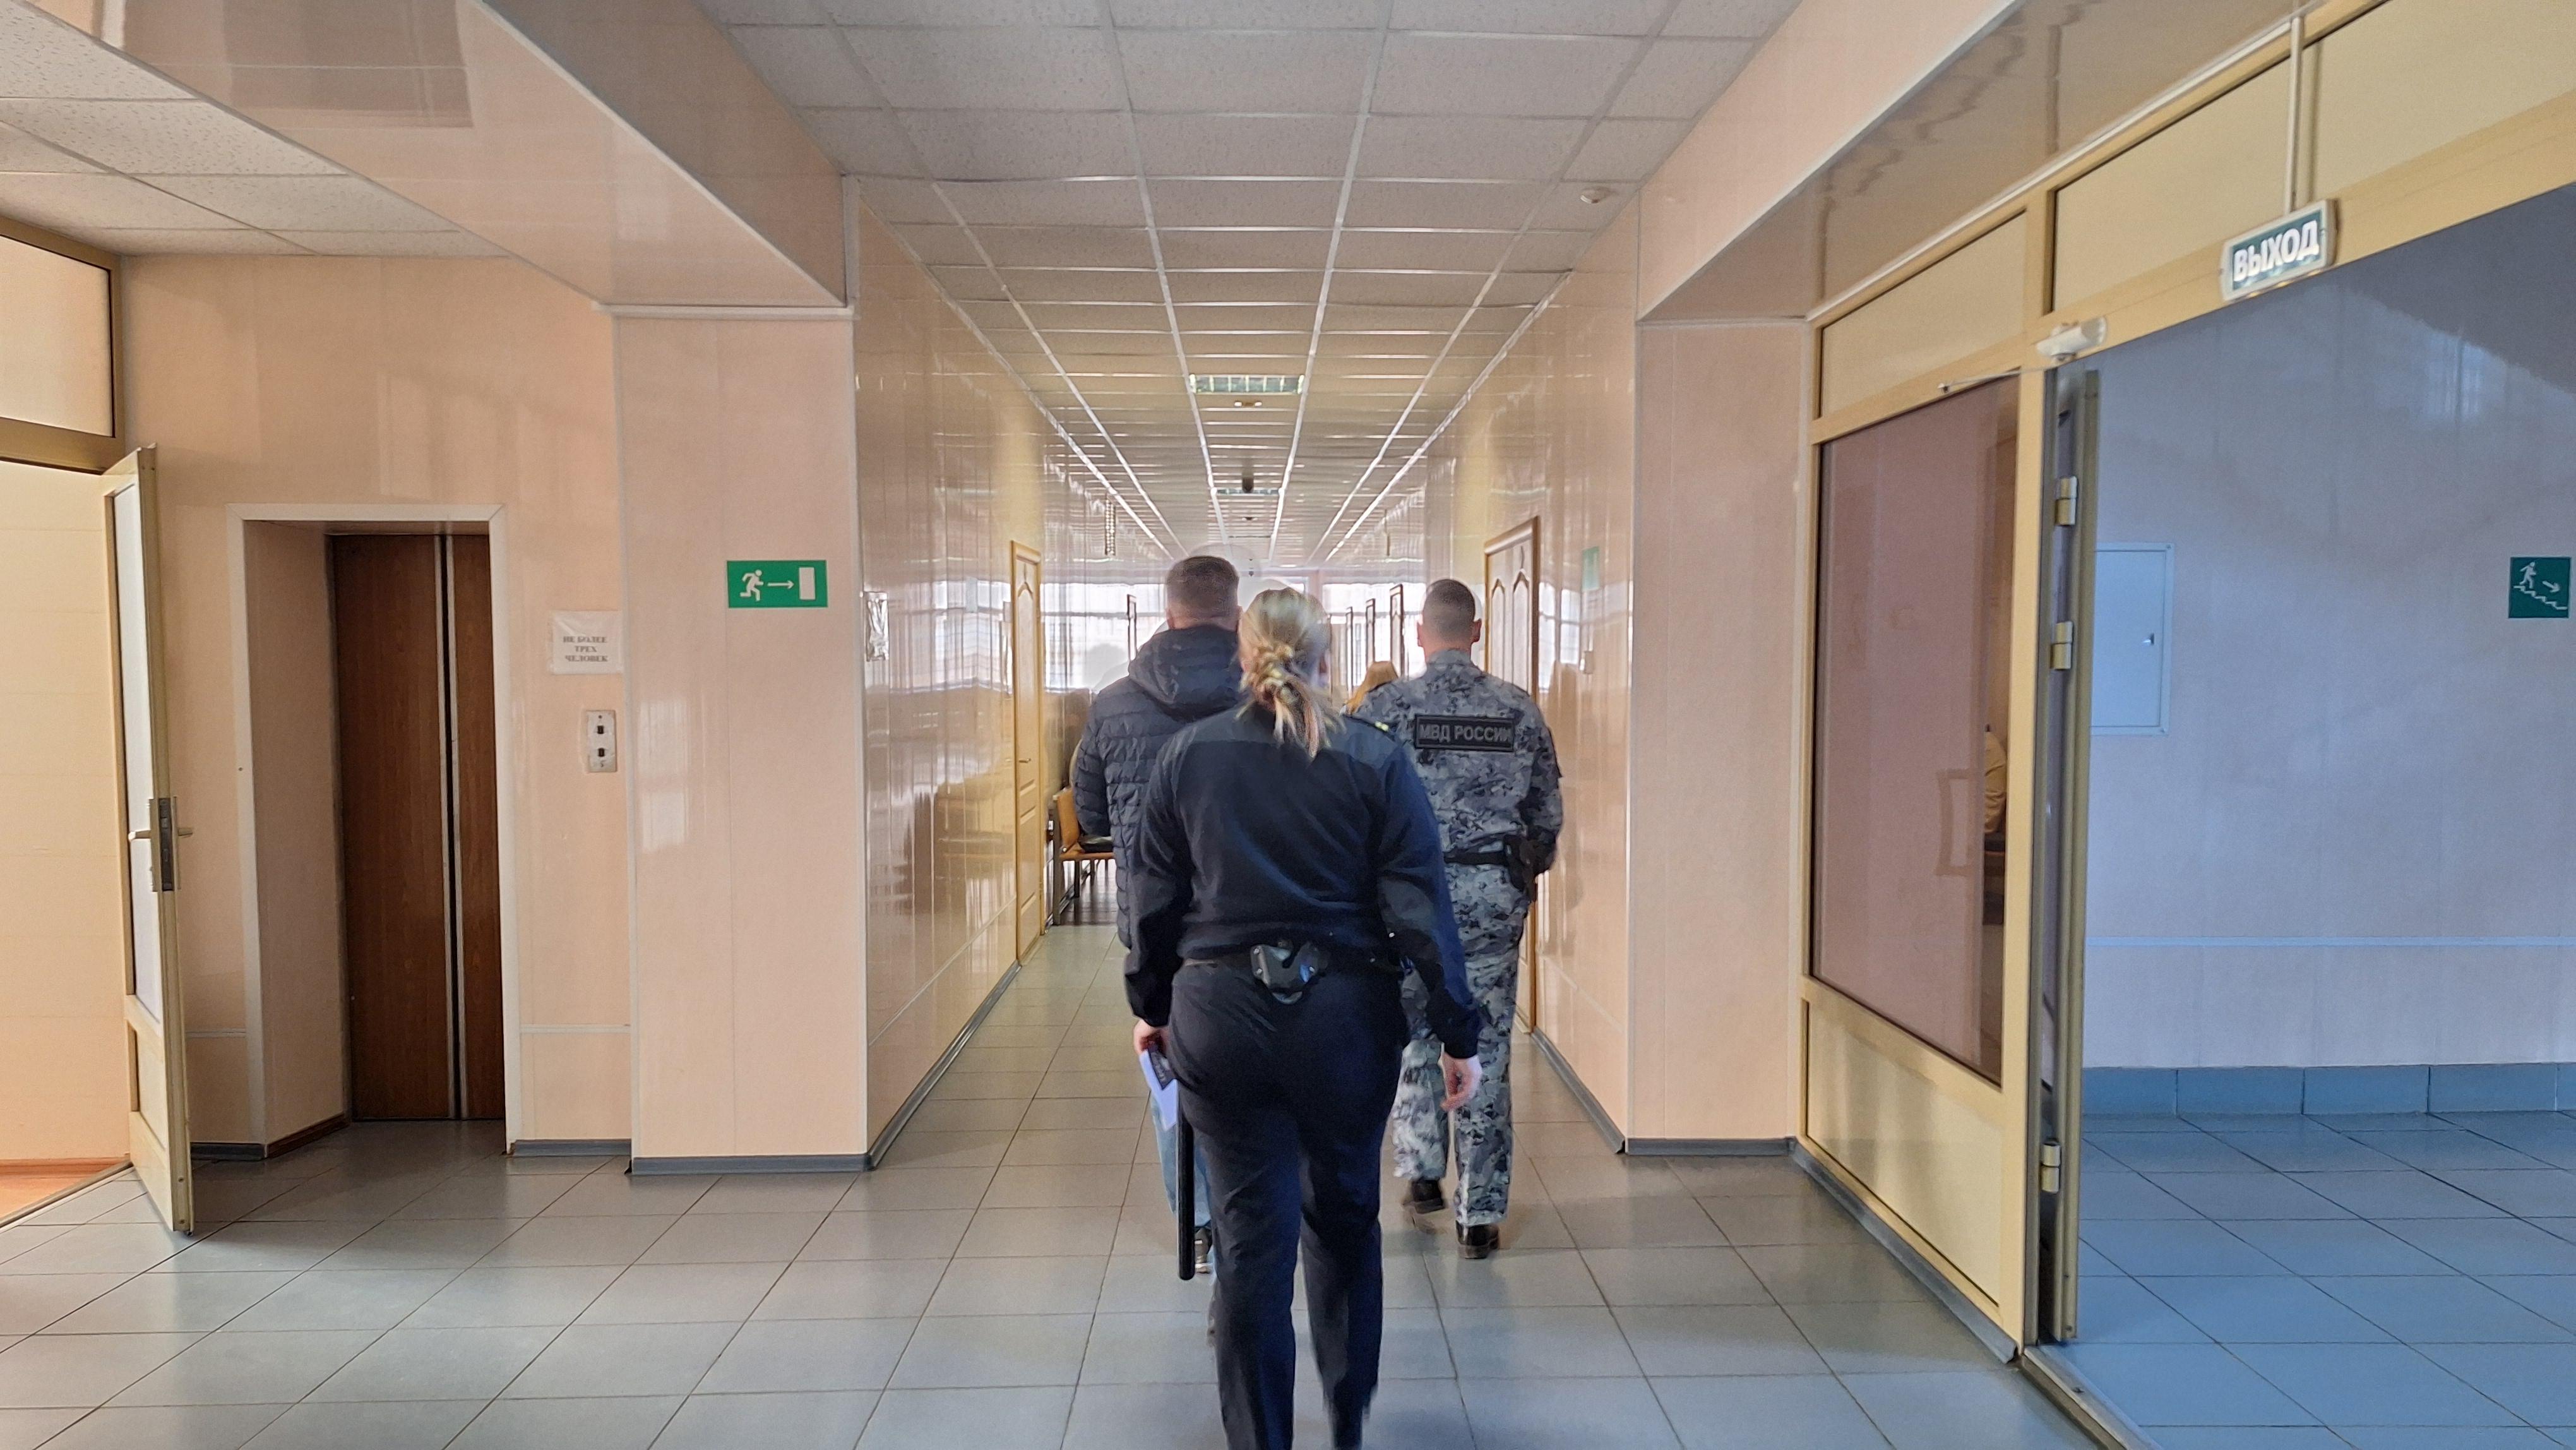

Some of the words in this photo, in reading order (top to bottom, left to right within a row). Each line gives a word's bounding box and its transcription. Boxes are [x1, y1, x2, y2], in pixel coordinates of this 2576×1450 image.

[2233, 220, 2320, 282] ВЫХОД
[1421, 724, 1451, 743] МВД
[1454, 726, 1512, 742] РОССИИ
